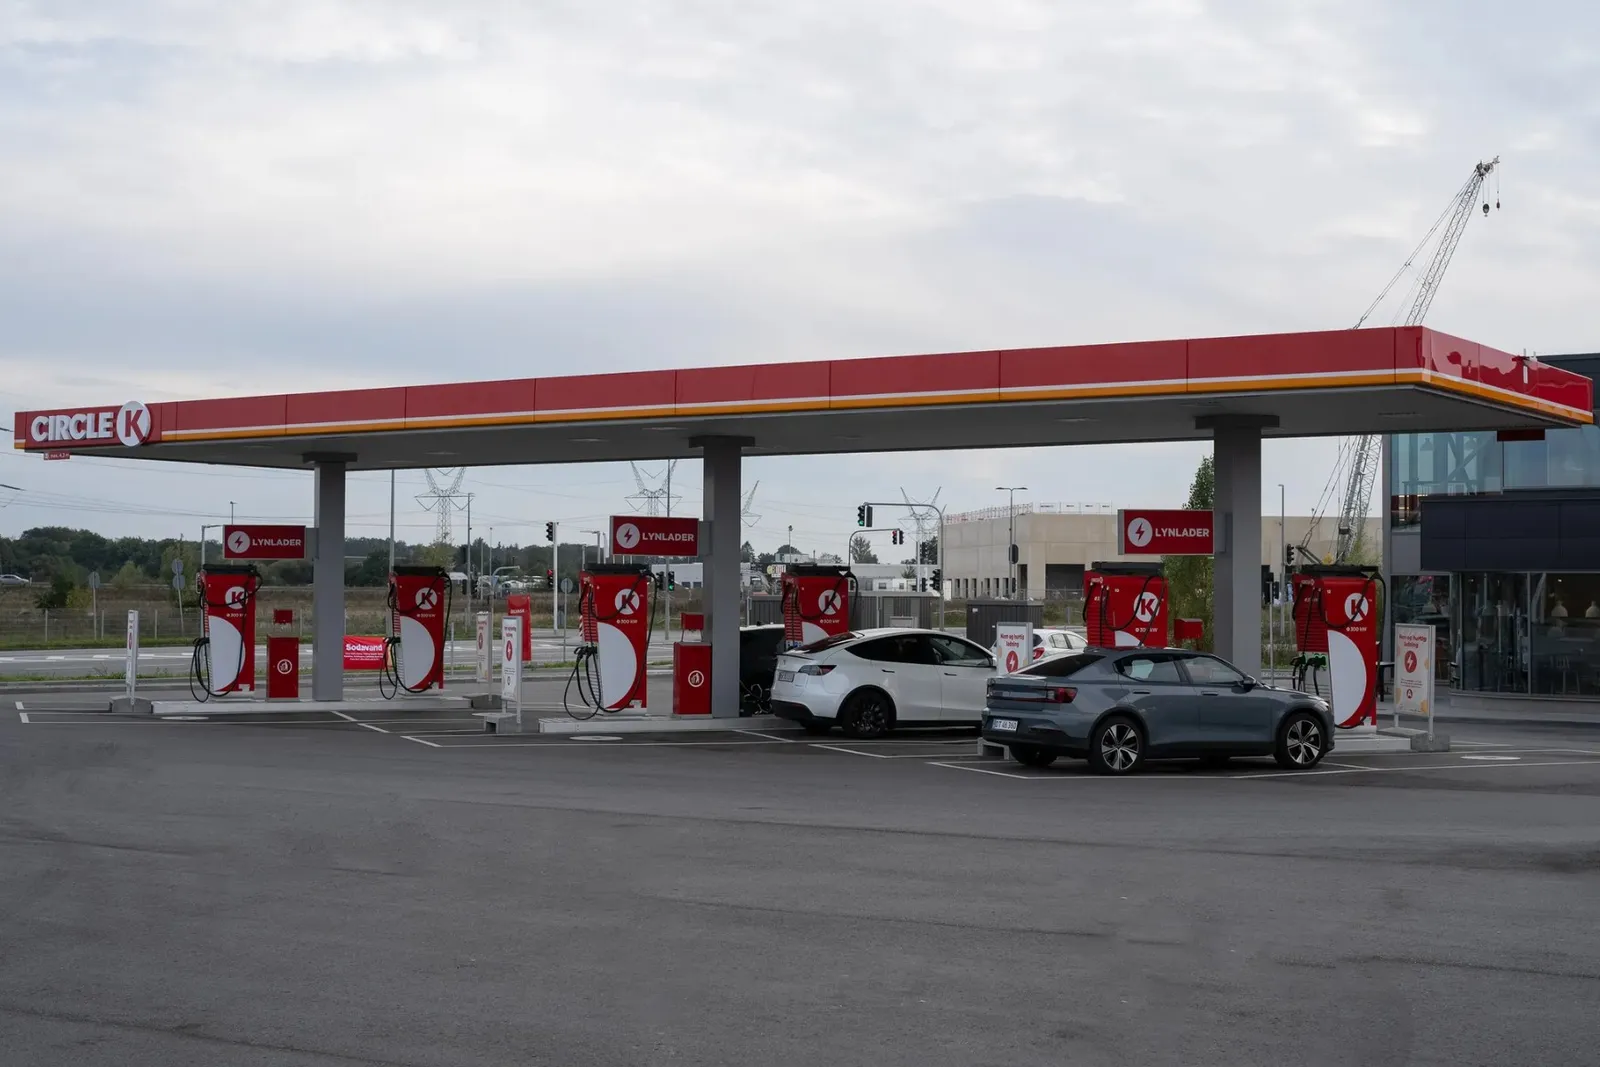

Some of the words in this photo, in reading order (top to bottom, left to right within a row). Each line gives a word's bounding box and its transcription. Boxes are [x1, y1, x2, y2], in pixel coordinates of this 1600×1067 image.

[31, 412, 114, 441] CIRCLE
[124, 409, 146, 444] K
[642, 532, 694, 541] LYNLADER
[1155, 528, 1210, 537] LYNLADER
[252, 538, 302, 546] LYNLADER
[346, 643, 382, 651] Sodavand
